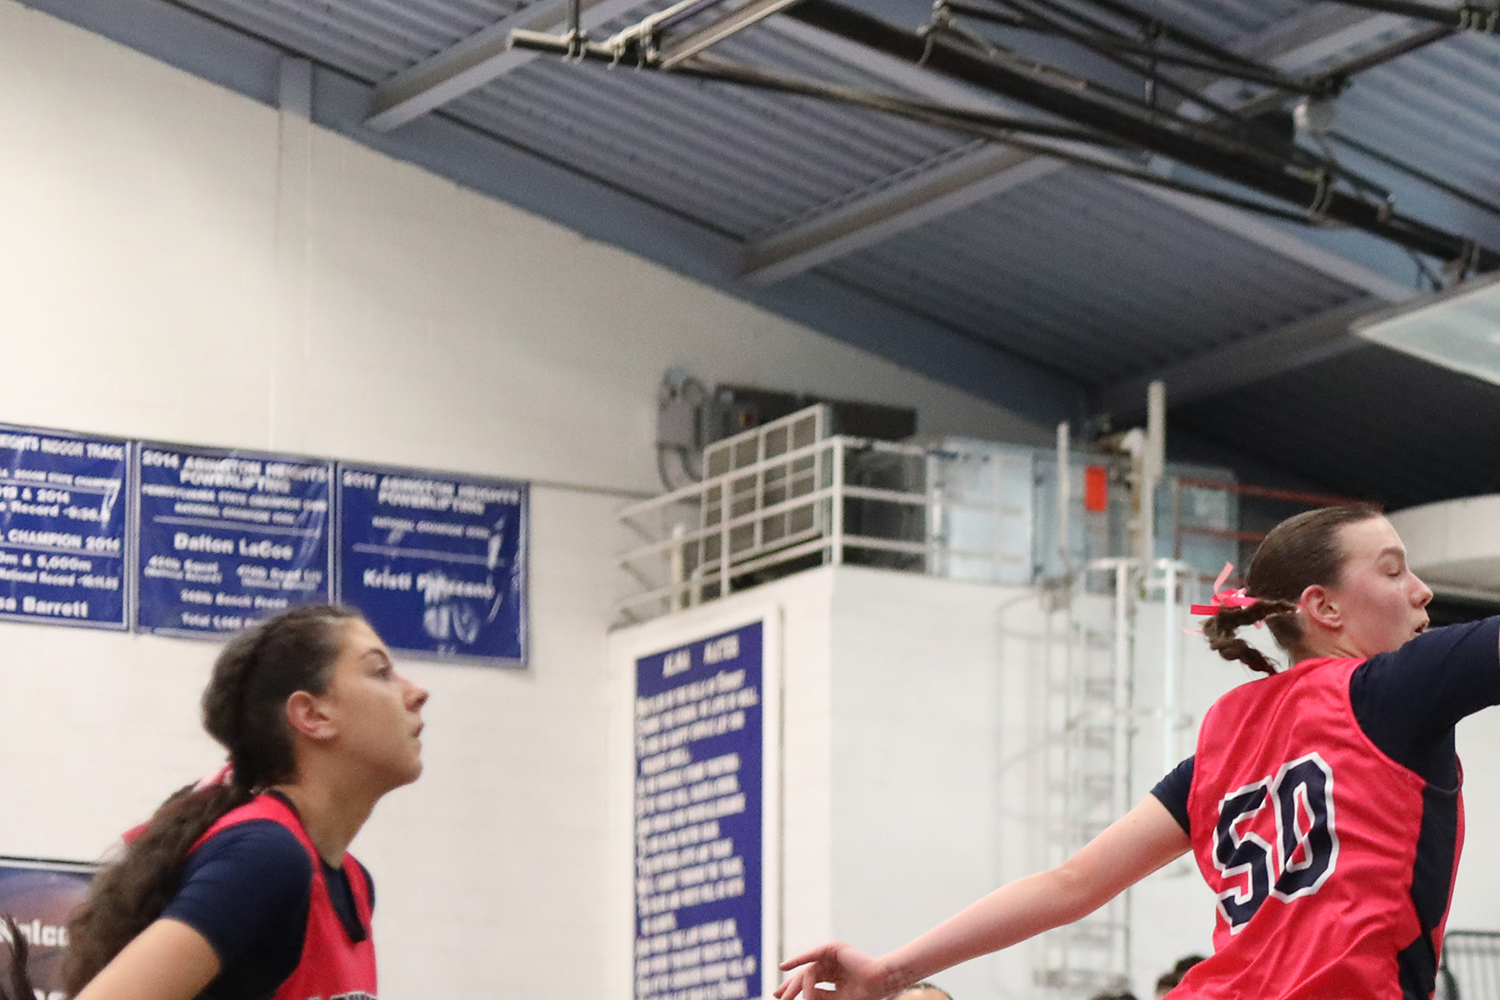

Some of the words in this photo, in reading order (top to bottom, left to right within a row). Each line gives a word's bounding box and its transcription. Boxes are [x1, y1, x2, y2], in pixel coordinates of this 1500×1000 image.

[7, 529, 82, 548] CHAMPION
[23, 596, 88, 618] Barrett
[1212, 752, 1339, 935] 50
